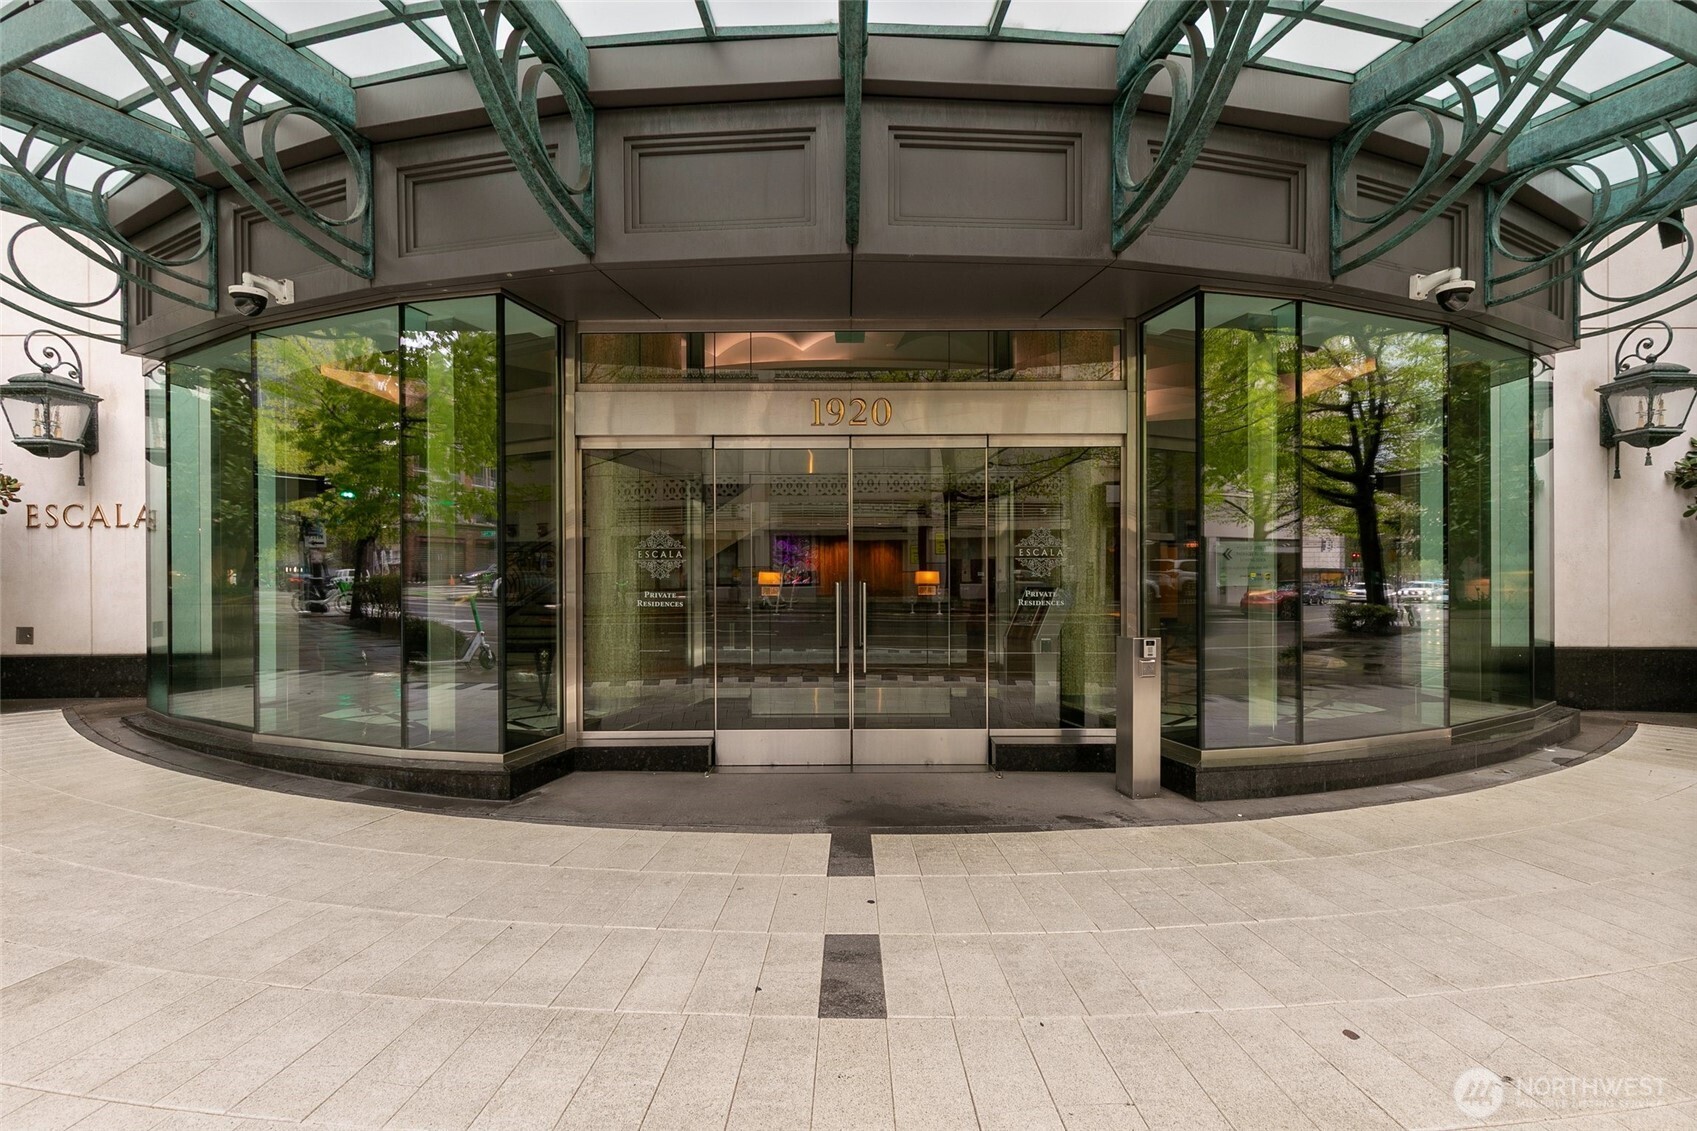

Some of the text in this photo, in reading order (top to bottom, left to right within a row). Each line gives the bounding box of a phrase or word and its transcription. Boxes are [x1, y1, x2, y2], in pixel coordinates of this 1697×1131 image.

[810, 397, 893, 427] 1920
[26, 504, 147, 529] ESCALA
[638, 550, 682, 559] ESCALA
[1019, 548, 1064, 557] ESCALA
